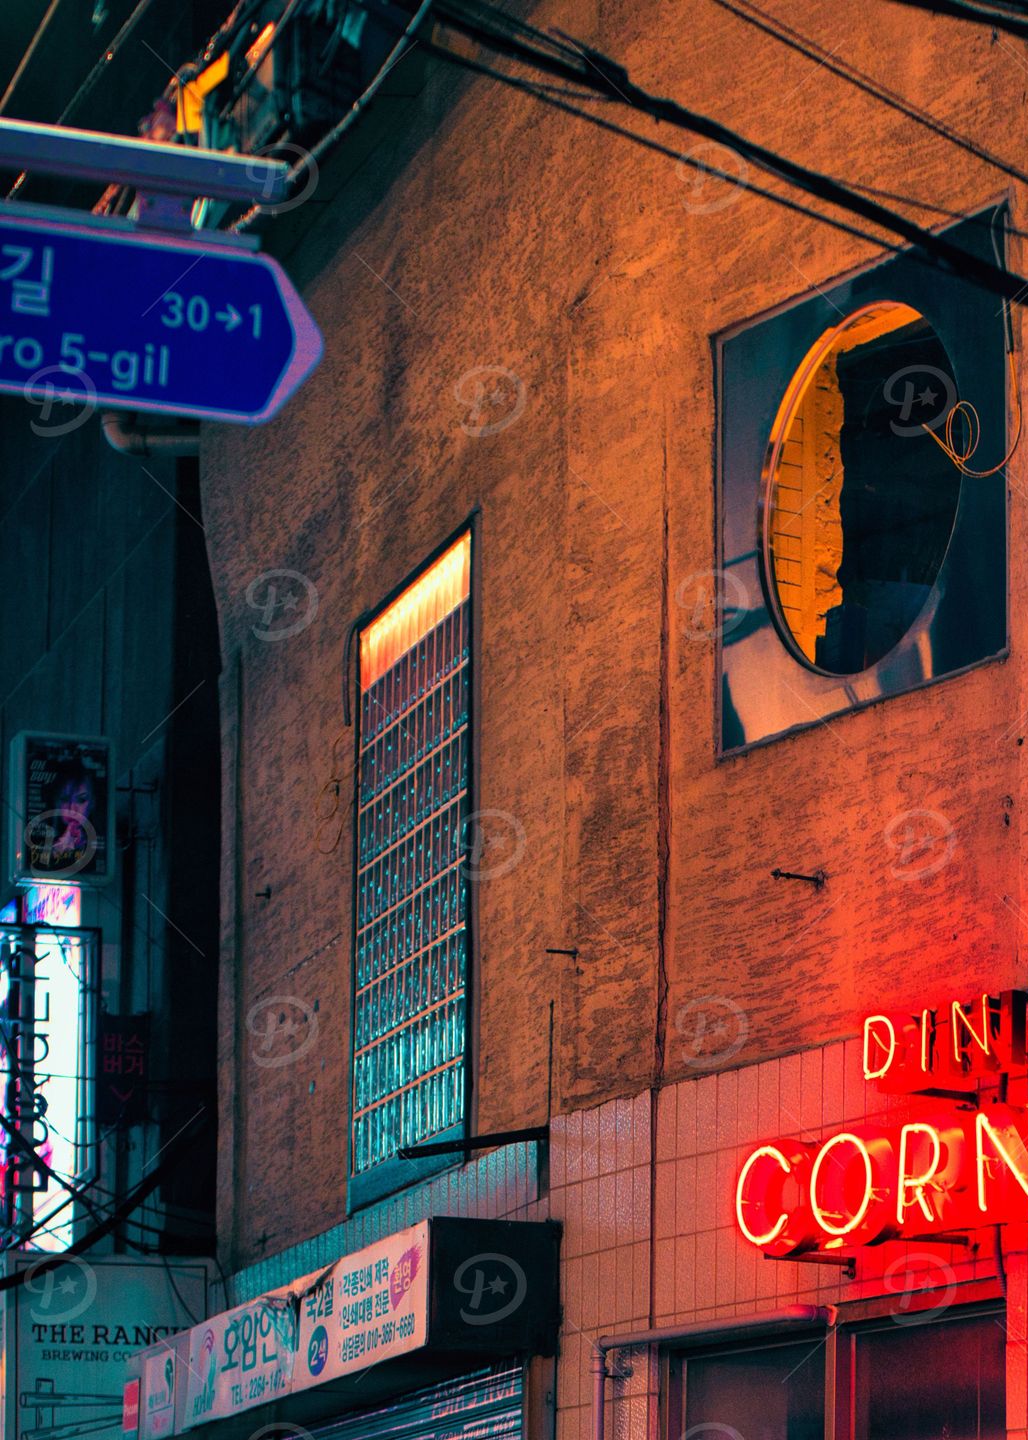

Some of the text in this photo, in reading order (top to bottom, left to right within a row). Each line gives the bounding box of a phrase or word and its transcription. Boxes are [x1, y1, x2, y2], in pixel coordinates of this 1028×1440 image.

[59, 332, 170, 391] 5-gil
[33, 1323, 196, 1346] THE RANC
[41, 1349, 105, 1363] BREWING
